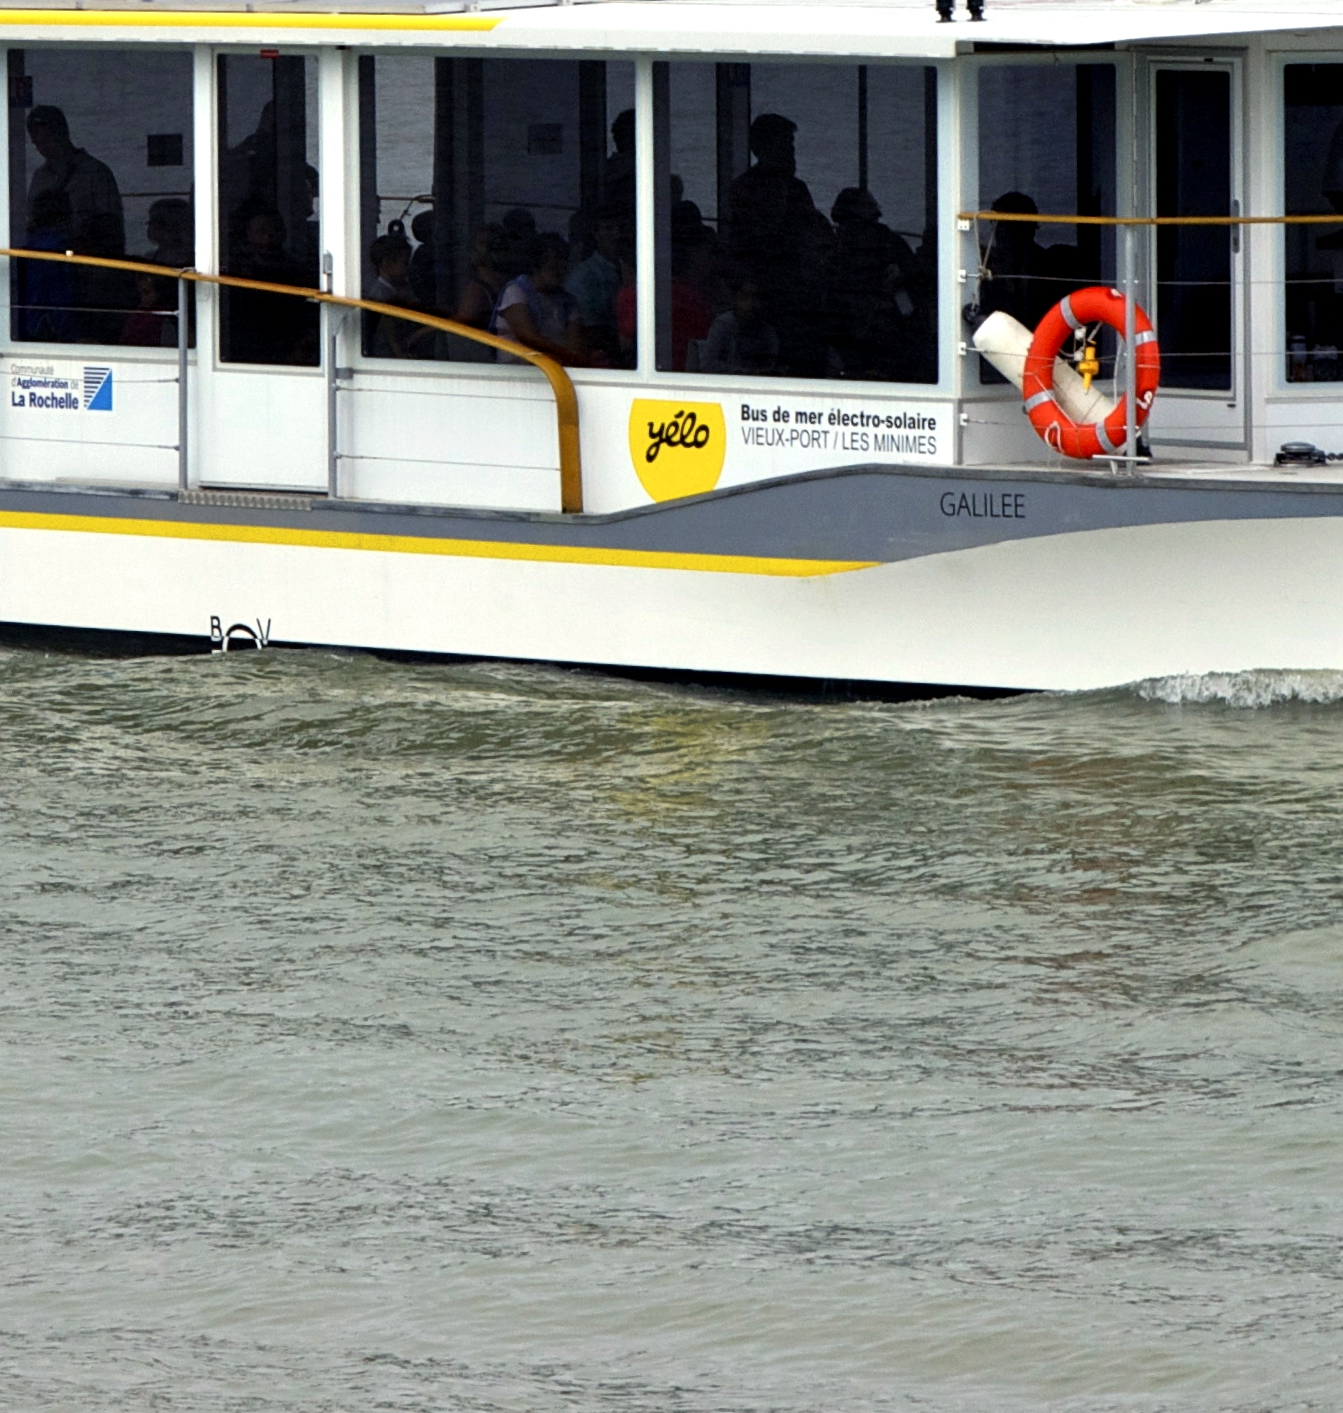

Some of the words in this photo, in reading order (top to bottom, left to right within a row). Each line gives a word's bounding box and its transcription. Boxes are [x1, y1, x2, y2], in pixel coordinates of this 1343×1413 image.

[11, 363, 54, 375] Communauté
[11, 391, 26, 407] La
[29, 391, 79, 410] Rochelle
[741, 404, 768, 422] Bus
[773, 406, 790, 423] de
[795, 410, 824, 425] mer
[828, 407, 937, 431] électro-solaire
[645, 410, 710, 463] yélo
[741, 427, 829, 449] VIEUX-PORT
[842, 432, 869, 452] LES
[874, 434, 937, 455] MINIMES
[940, 492, 1026, 518] GALILEE
